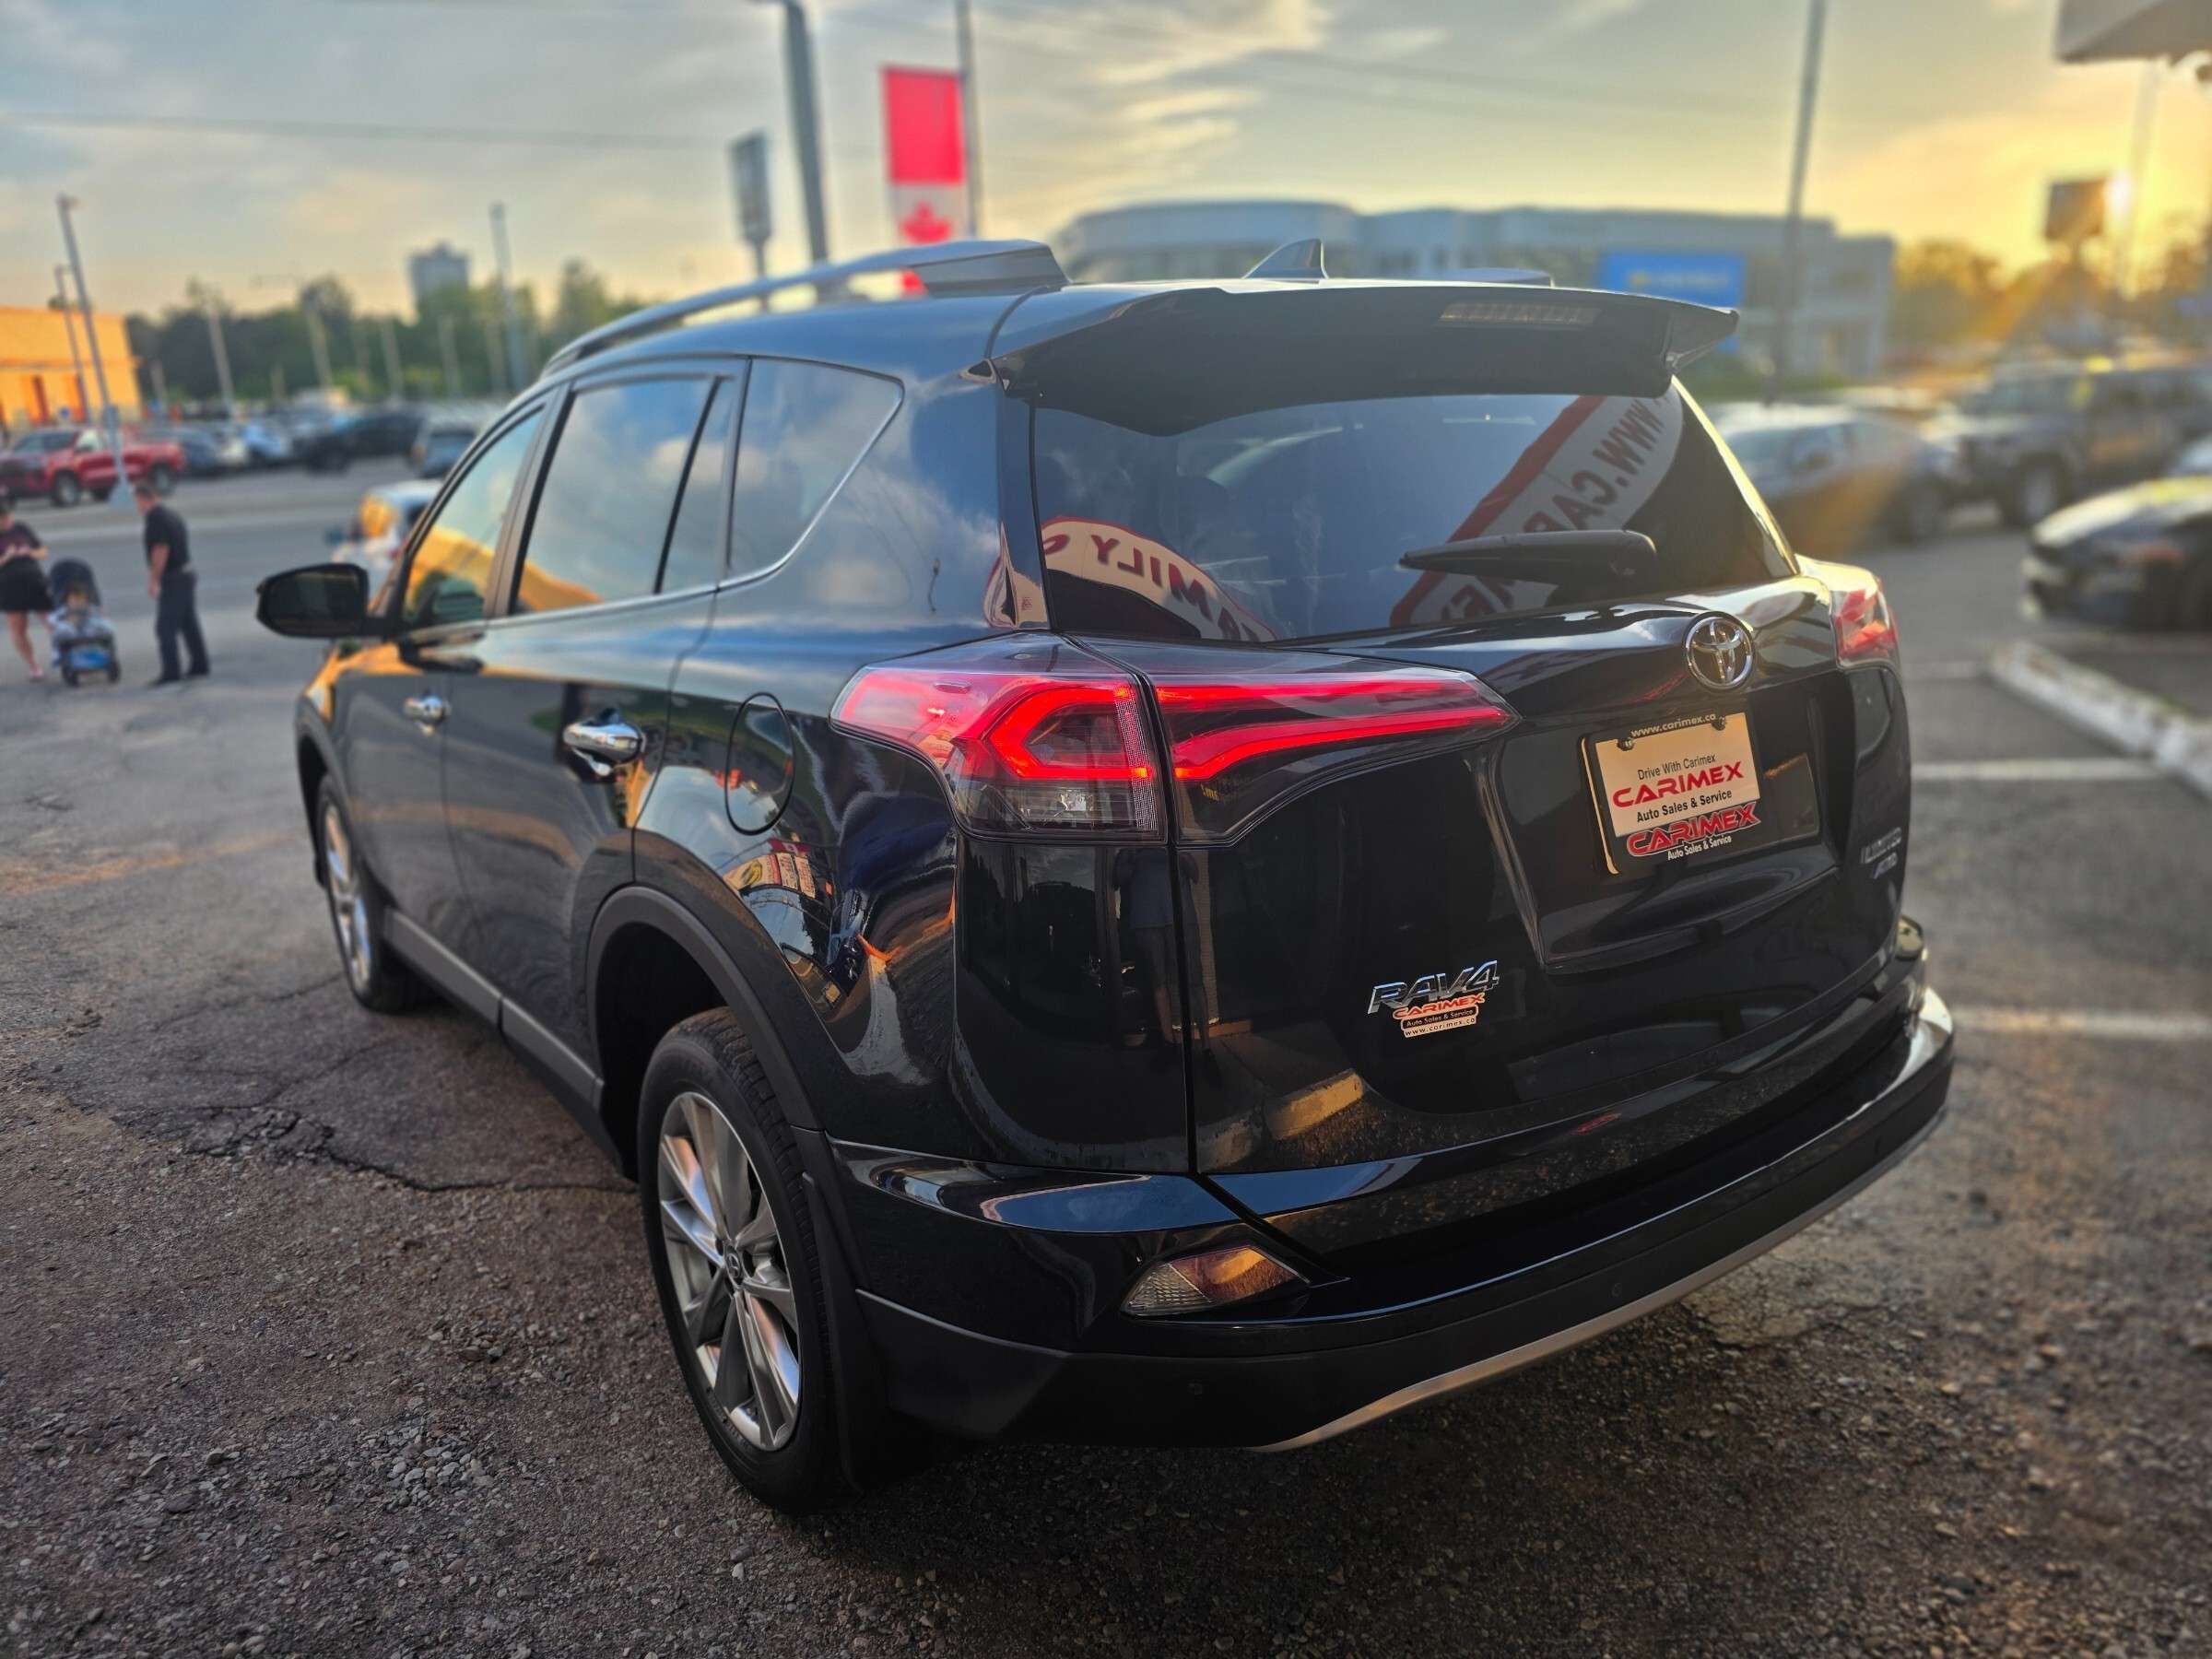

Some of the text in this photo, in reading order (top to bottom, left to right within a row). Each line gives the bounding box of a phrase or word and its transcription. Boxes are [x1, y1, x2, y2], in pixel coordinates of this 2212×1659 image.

[1637, 753, 1716, 781] Drive With Carimex
[1612, 761, 1745, 808] CARIMEX
[1637, 788, 1733, 823] Auto Sales & Service
[1628, 802, 1759, 855] CARIMEX
[1667, 835, 1732, 861] Auto Sales & Service
[1367, 959, 1500, 1014] RAV4
[1394, 993, 1485, 1018] CARIMEX
[1406, 1018, 1423, 1028] Auto
[1424, 1015, 1441, 1025] Sales
[1450, 1009, 1474, 1018] Service
